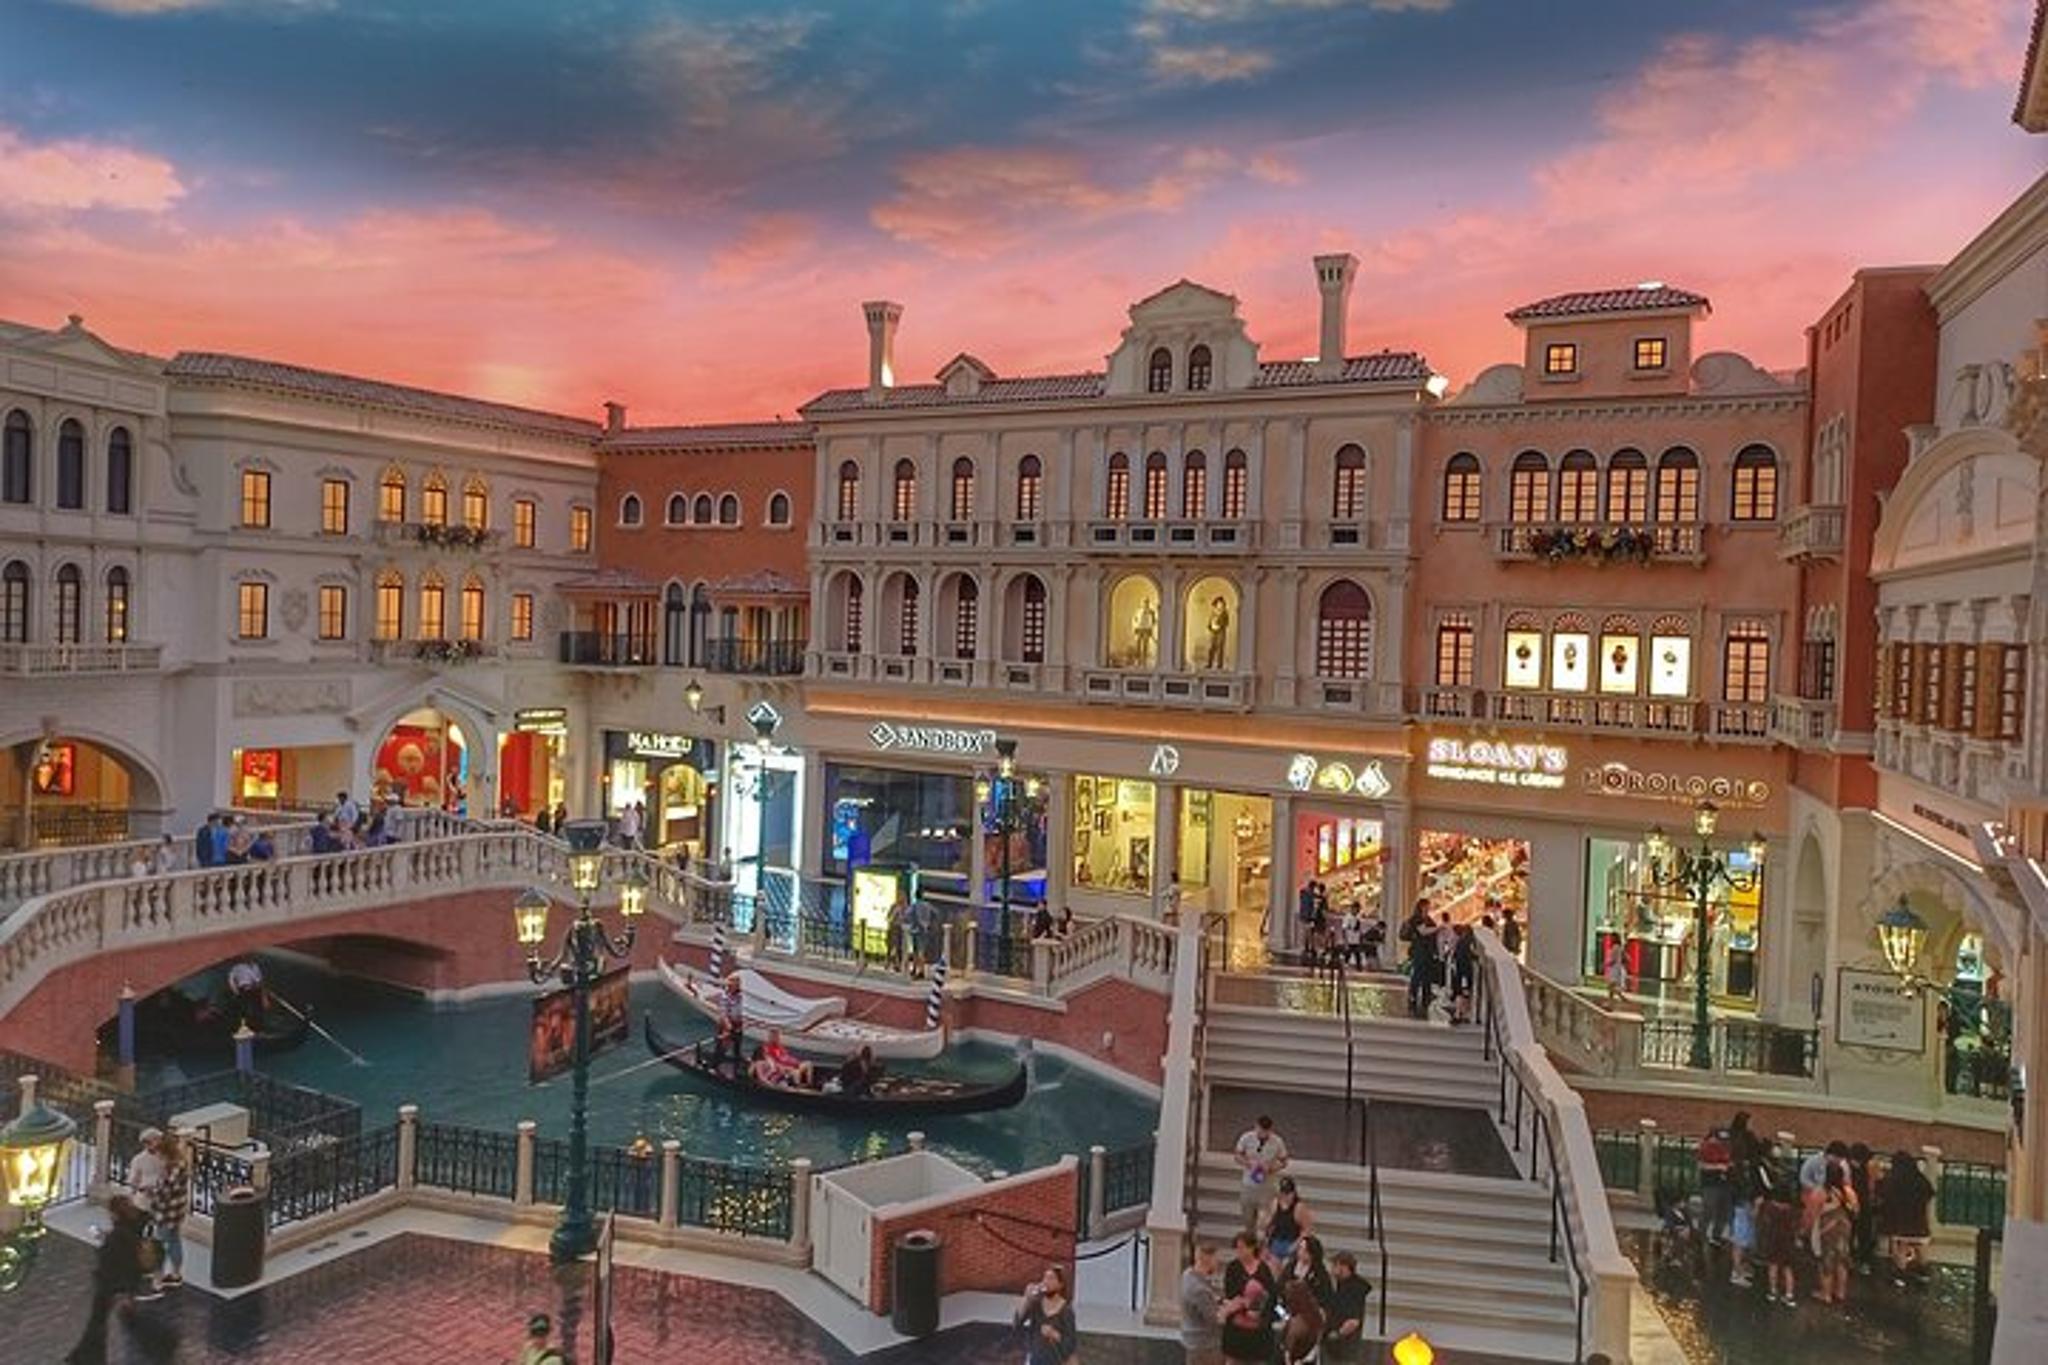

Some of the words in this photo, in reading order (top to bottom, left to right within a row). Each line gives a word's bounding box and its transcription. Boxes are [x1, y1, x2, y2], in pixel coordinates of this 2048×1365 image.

[898, 727, 982, 752] SANDBOX
[1428, 738, 1568, 773] SLOAN'S
[1581, 762, 1769, 801] HOROLOGIO
